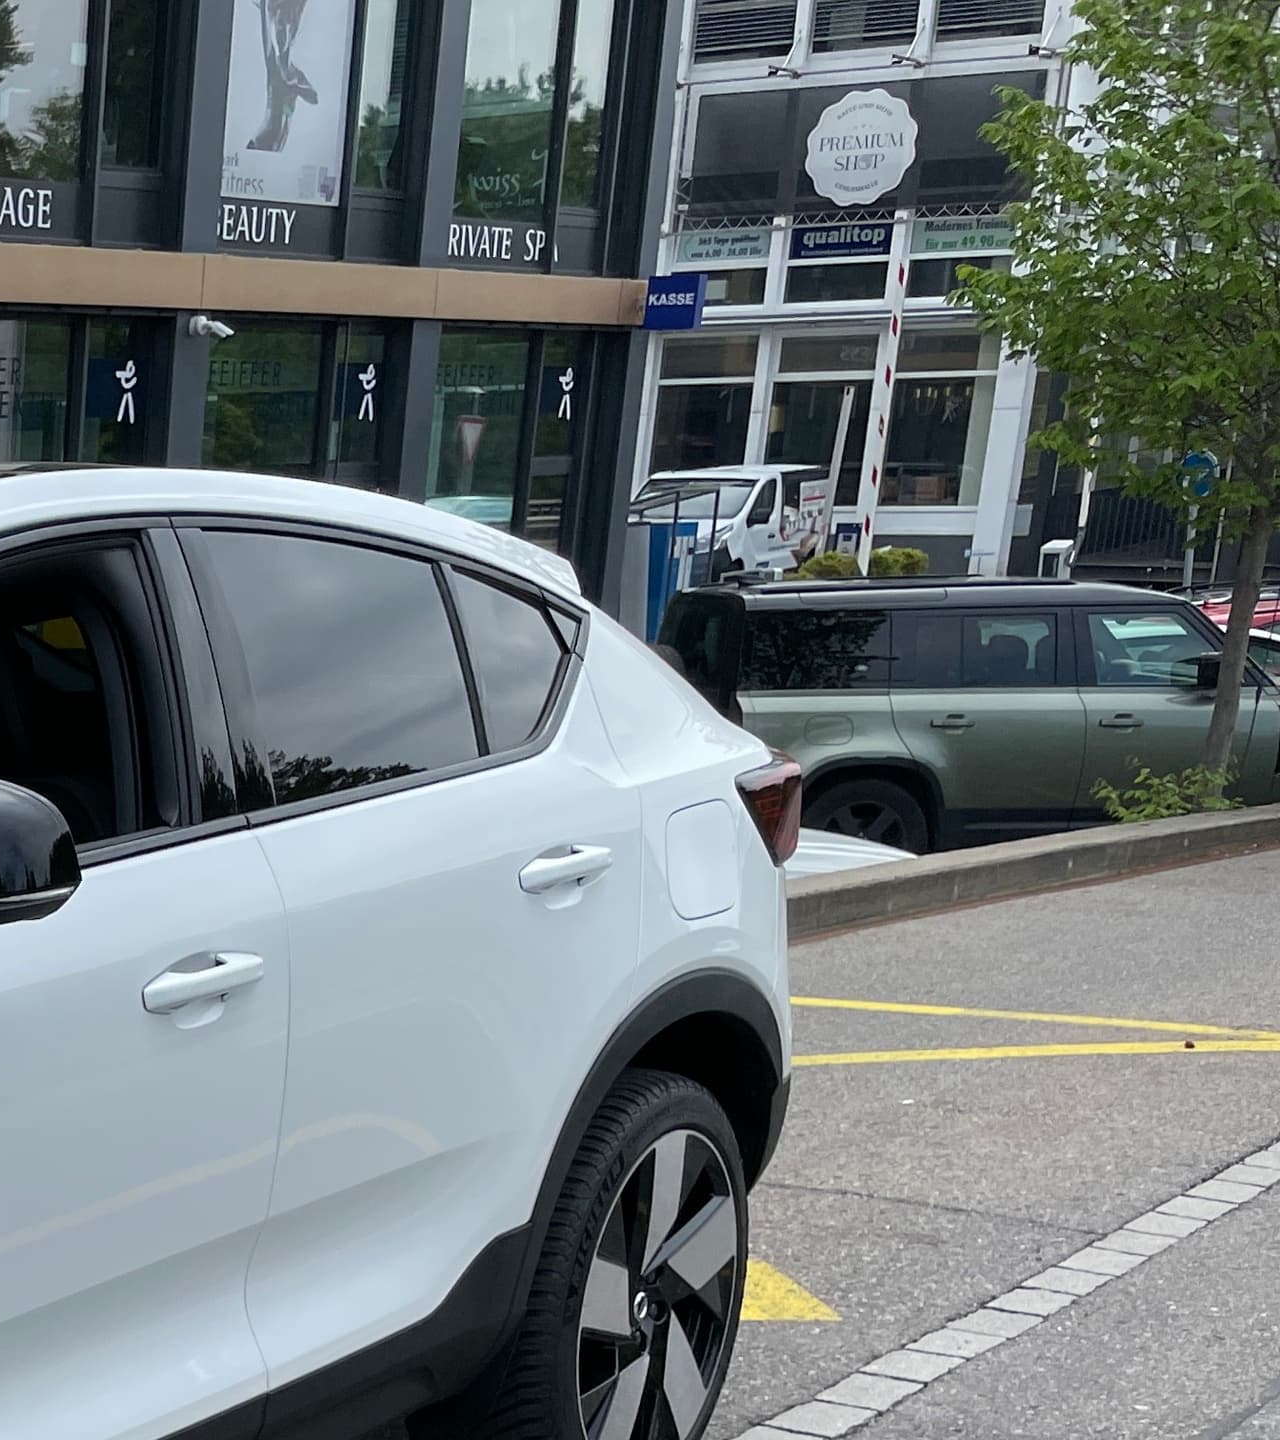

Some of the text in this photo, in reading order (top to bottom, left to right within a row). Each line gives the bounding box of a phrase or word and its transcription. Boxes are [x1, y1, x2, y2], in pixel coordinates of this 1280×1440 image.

[819, 132, 904, 153] PREMIUM
[833, 154, 886, 172] SHOP
[223, 168, 264, 194] itness
[217, 204, 297, 245] EAUTY
[924, 221, 973, 233] Modernes
[803, 225, 886, 249] qualitop
[647, 292, 696, 306] KASSE
